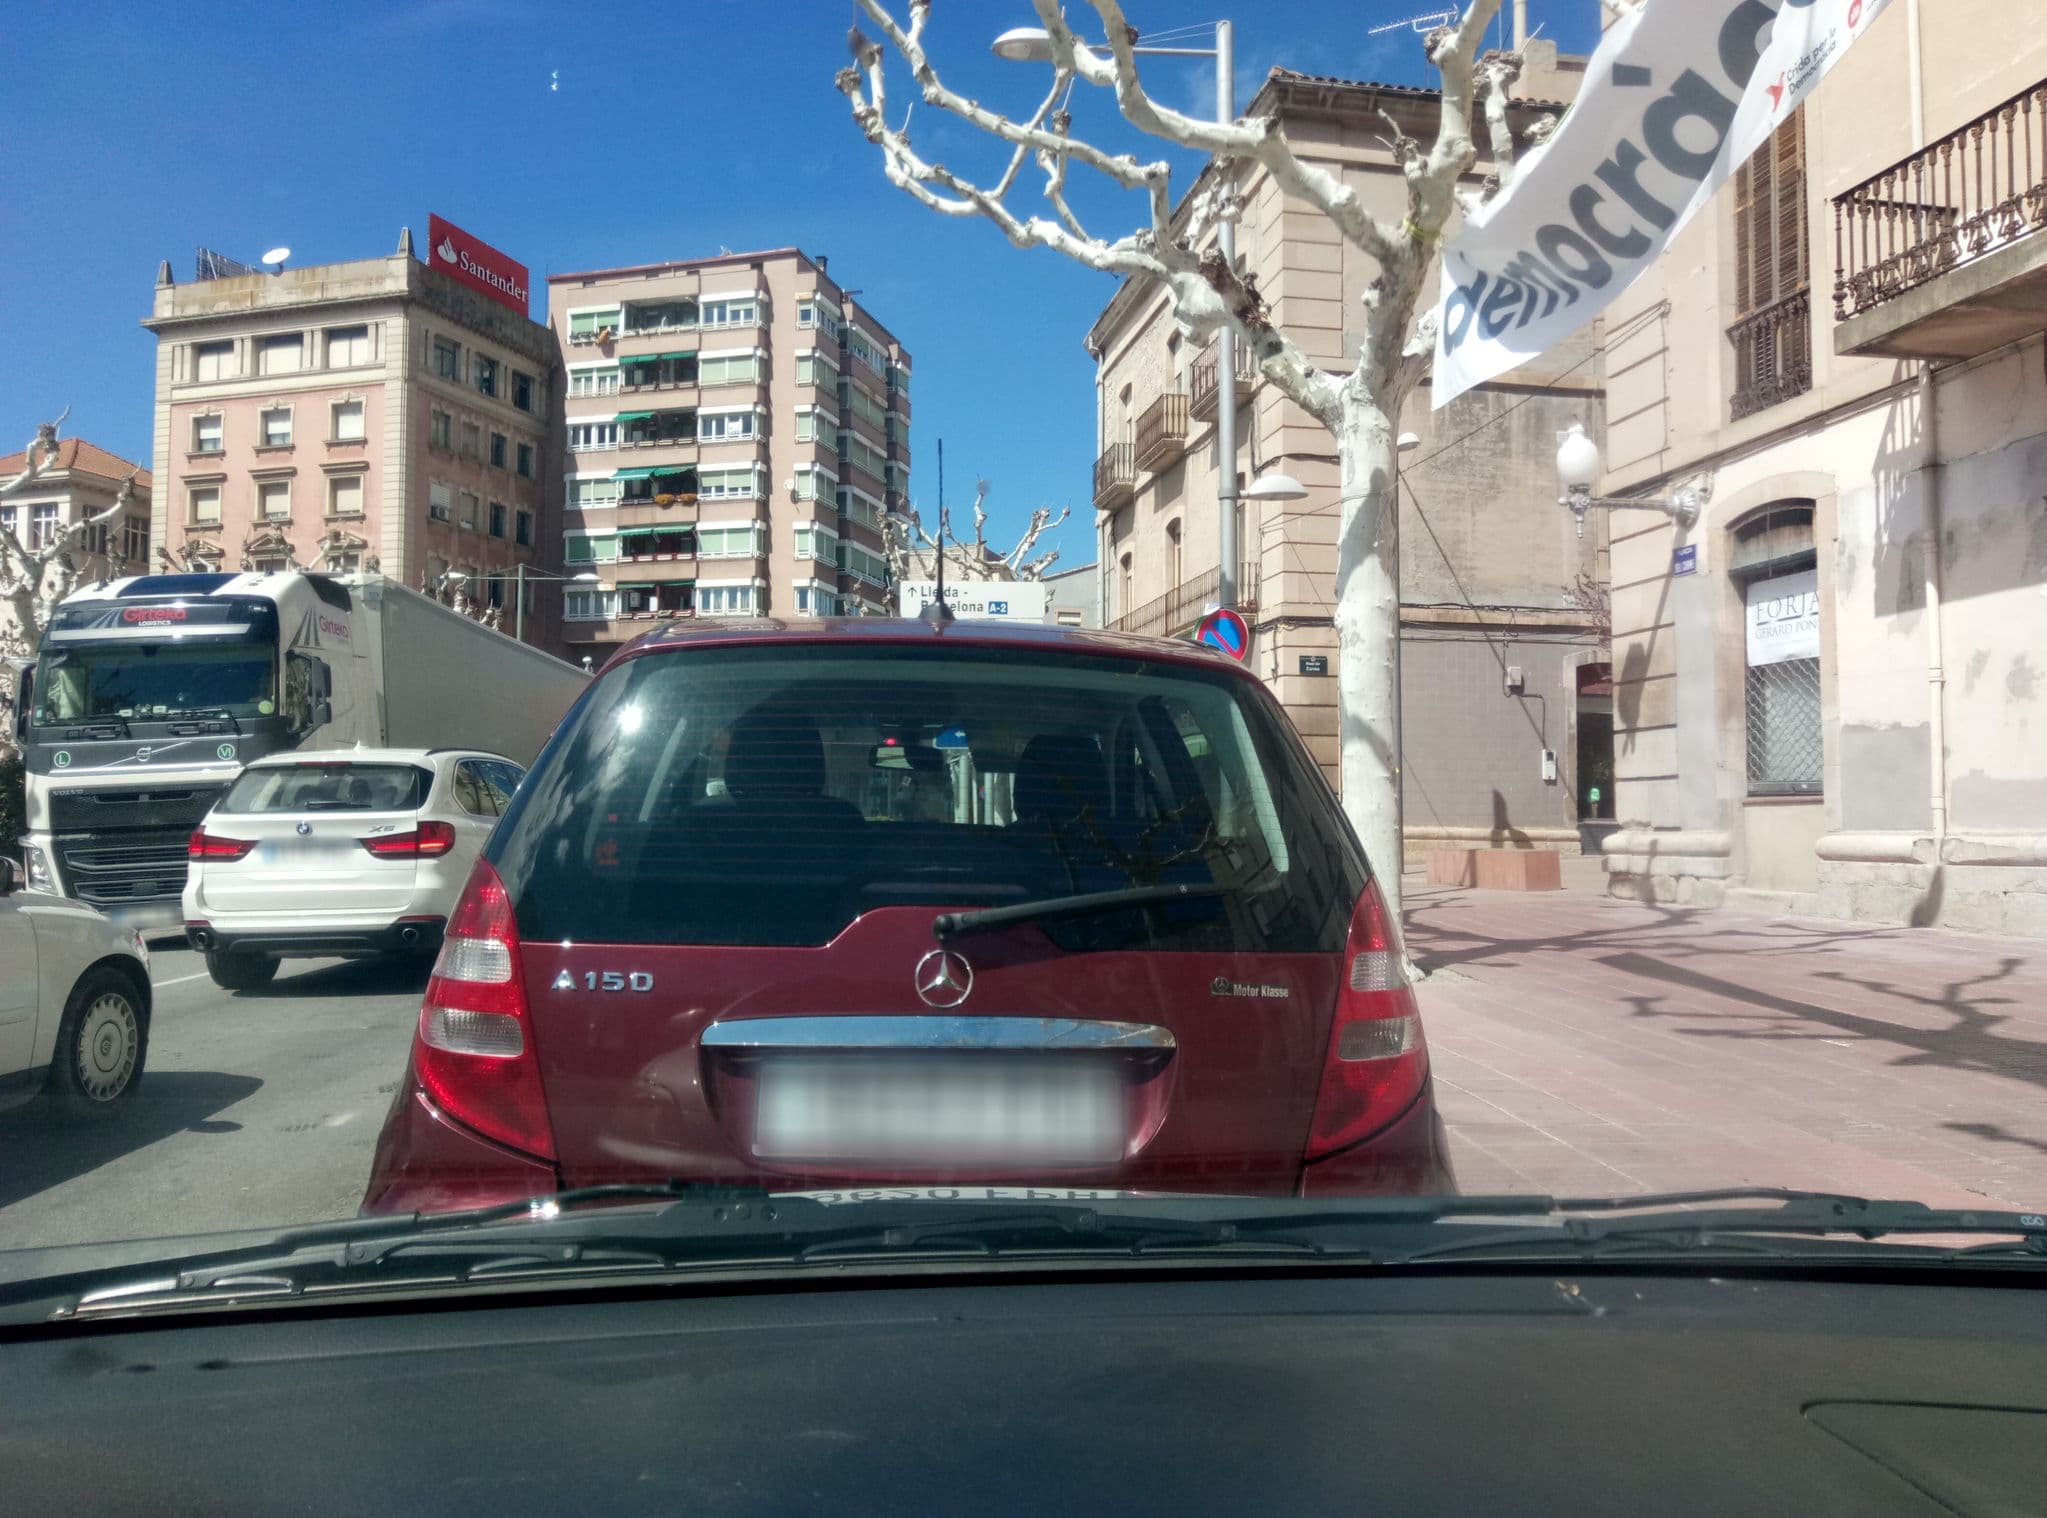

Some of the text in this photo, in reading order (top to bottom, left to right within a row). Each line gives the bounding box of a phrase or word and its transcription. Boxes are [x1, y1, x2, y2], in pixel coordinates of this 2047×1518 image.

[1786, 54, 1812, 81] Crida
[1812, 37, 1829, 60] per
[460, 250, 528, 303] Santander
[920, 586, 959, 598] Lleda
[920, 601, 1007, 613] Belona A-2
[1756, 592, 1819, 621] FORJA
[1233, 984, 1289, 998] Motor Klasse
